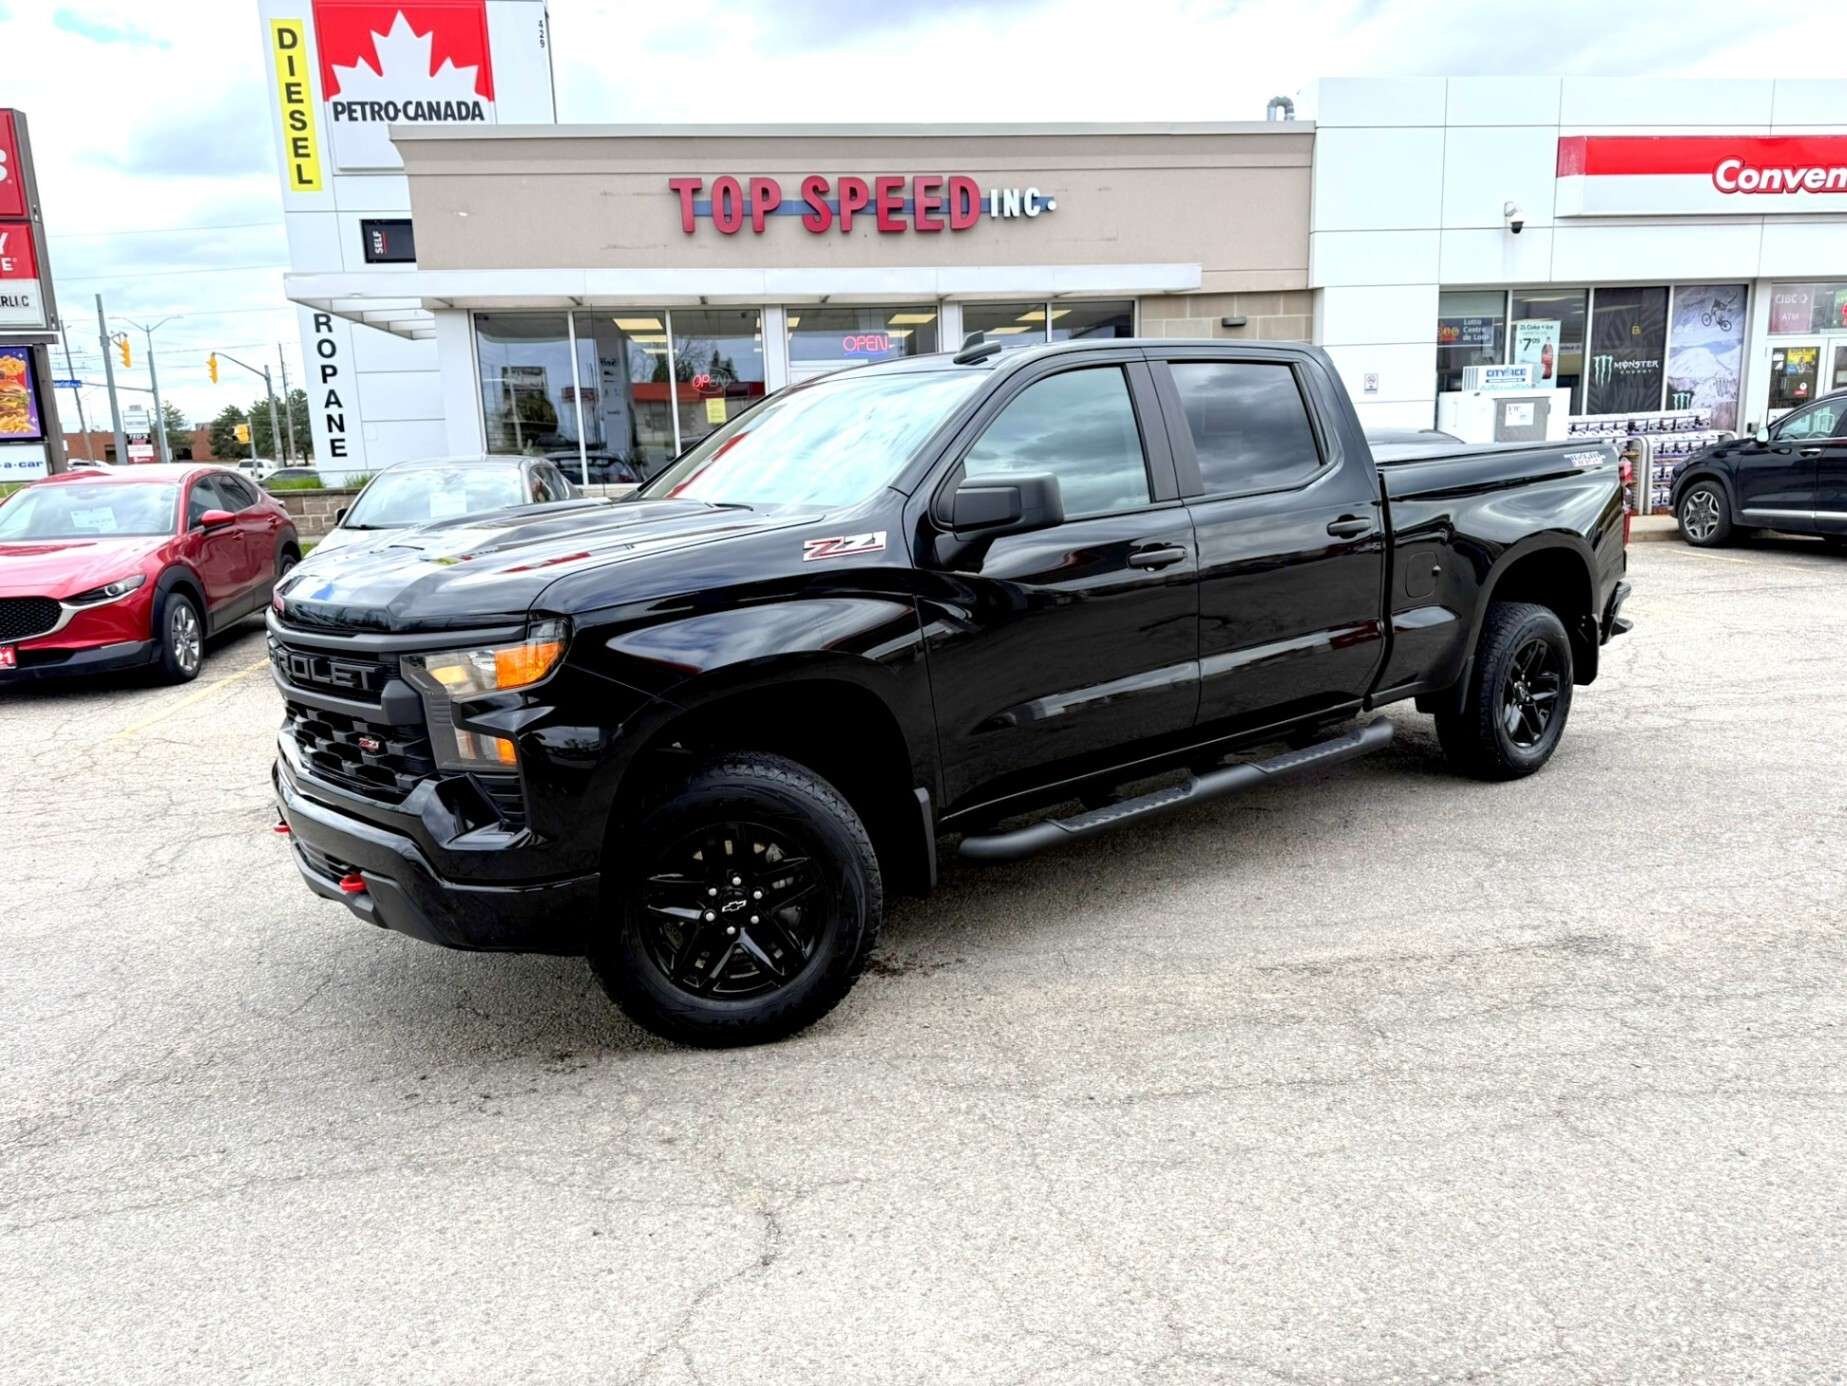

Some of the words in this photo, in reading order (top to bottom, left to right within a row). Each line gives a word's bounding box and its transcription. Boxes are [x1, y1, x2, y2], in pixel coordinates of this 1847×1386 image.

[277, 27, 314, 184] DIESEL
[669, 175, 782, 234] TOP
[800, 175, 981, 234] SPEED
[372, 231, 384, 255] SELF
[842, 335, 889, 352] OPEN
[1486, 369, 1506, 378] CITY
[1614, 360, 1659, 370] MONSTER
[313, 313, 348, 458] ROPANE
[803, 531, 887, 561] Z71
